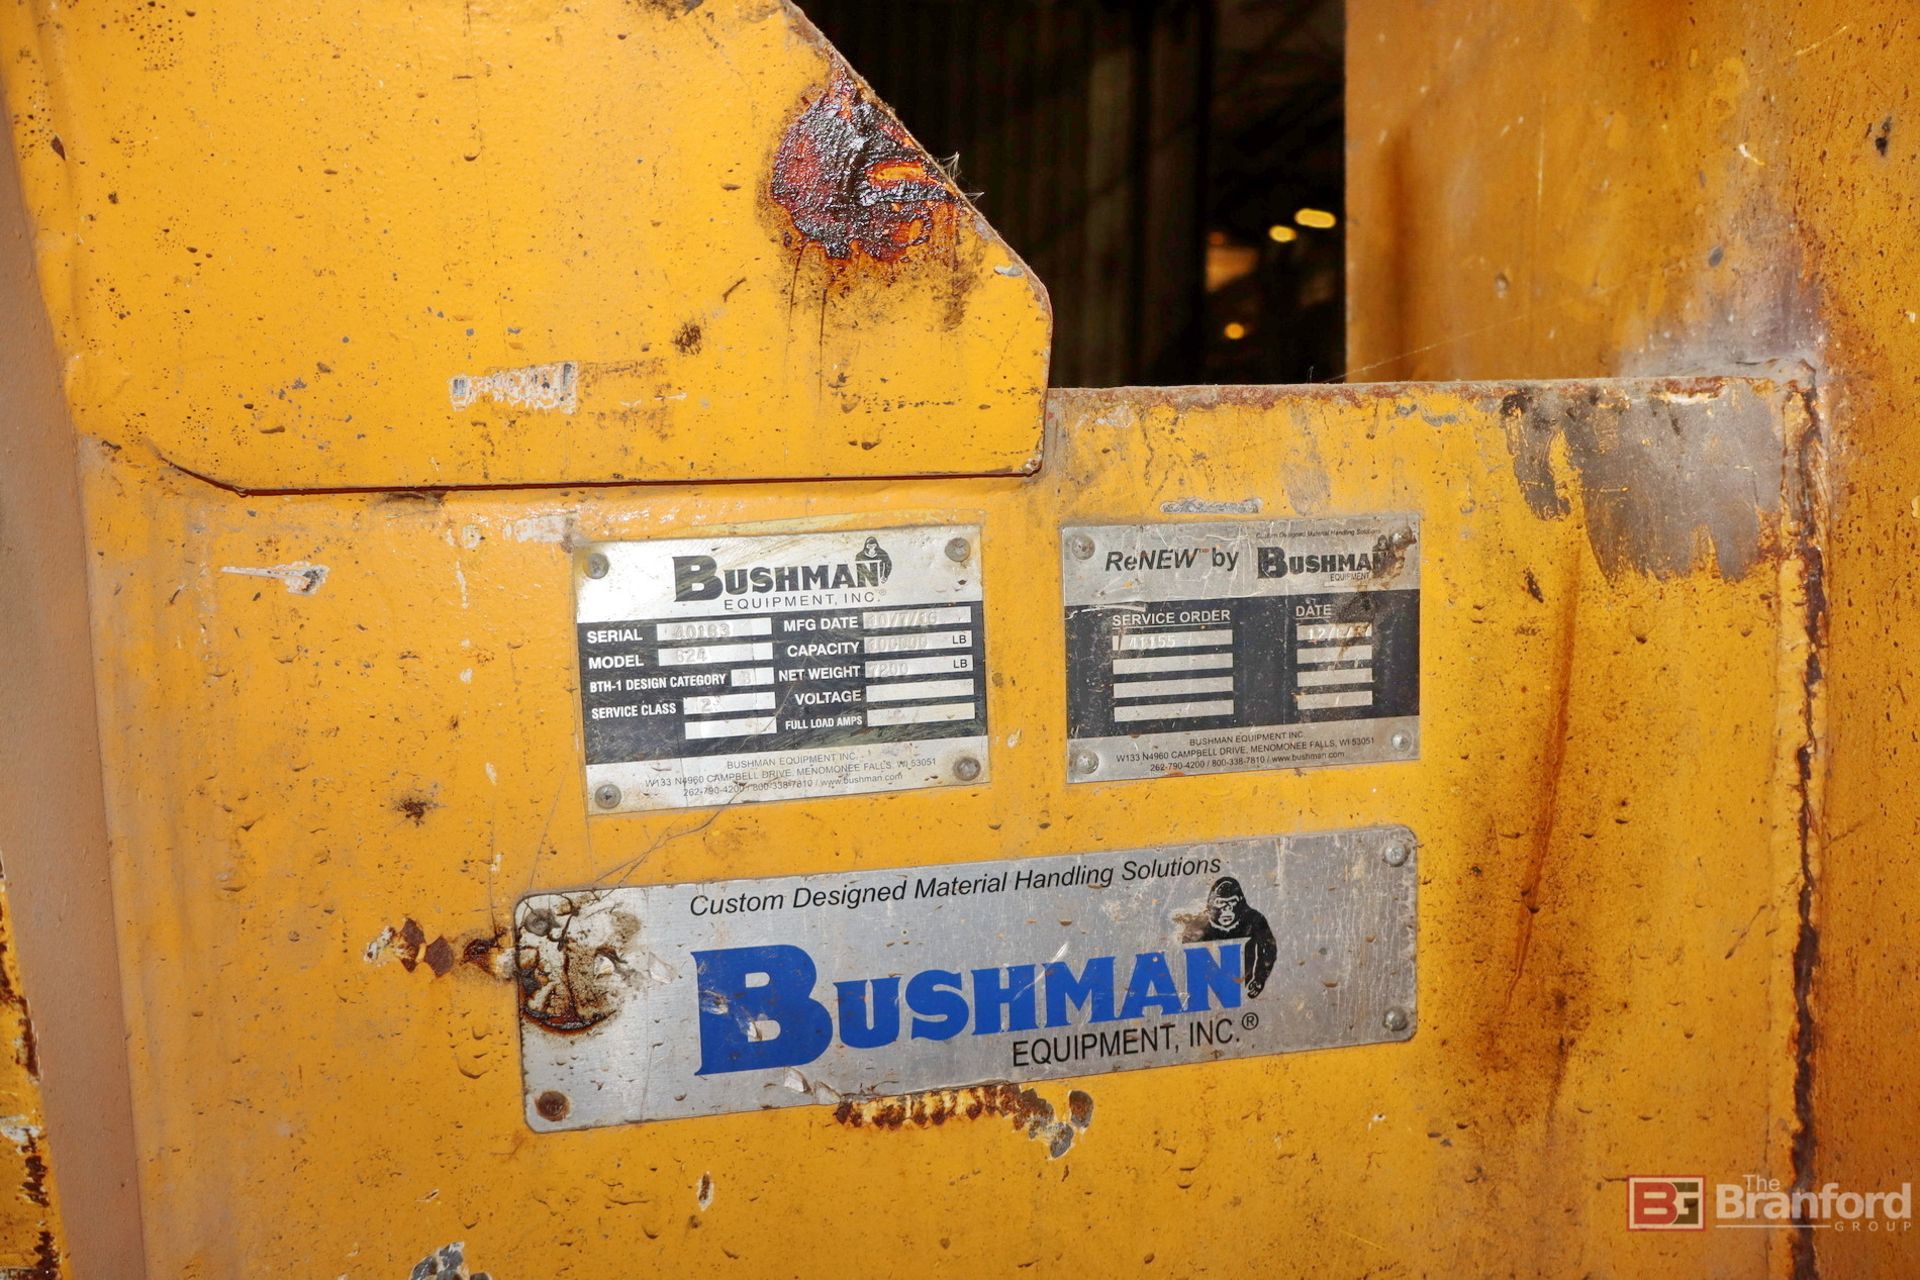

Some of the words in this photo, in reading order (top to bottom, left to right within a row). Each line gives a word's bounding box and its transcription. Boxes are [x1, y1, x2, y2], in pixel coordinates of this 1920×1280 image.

[1212, 547, 1239, 572] by
[672, 555, 880, 602] BUSHMAN
[1330, 572, 1370, 582] EQUIPMENT
[724, 593, 838, 611] EQUIPMENT,
[1296, 604, 1331, 617] DATE
[783, 618, 816, 633] MFG
[820, 616, 859, 630] DATE
[1113, 612, 1175, 627] SERVICE
[1180, 609, 1231, 623] ORDER
[587, 629, 643, 644] SERIAL
[787, 642, 860, 658] CAPACITY
[952, 634, 967, 645] LB
[588, 654, 645, 669] MODEL
[778, 669, 804, 682] NET
[808, 665, 861, 680] WEIGHT
[953, 658, 968, 669] LB
[590, 679, 622, 693] BTH-1
[626, 677, 667, 691] DESIGN
[670, 673, 726, 688] CATEGORY
[795, 690, 861, 705] VOLTAGE
[591, 704, 638, 720] SERVICE
[641, 702, 677, 717] CLASS
[785, 720, 808, 730] FULL
[810, 718, 834, 728] LOAD
[836, 715, 863, 726] AMPS
[1190, 736, 1233, 746] BUSHMAN
[1235, 731, 1286, 743] EQUIPMENT
[1116, 753, 1140, 763] W133
[1142, 752, 1168, 761] N4960
[1171, 749, 1217, 760] CAMPBELL
[1250, 742, 1307, 753] MENOMONEE
[1339, 739, 1351, 747] WI
[1352, 737, 1375, 746] 53051
[727, 758, 776, 770] BUSHMAN
[779, 753, 836, 766] EQUIPMENT
[1150, 761, 1205, 772] 262-790-4200
[1212, 756, 1265, 768] 800-338-7810
[1271, 751, 1345, 763] www.bushman.com
[645, 777, 672, 788] W133
[675, 775, 704, 786] N4960
[707, 771, 759, 783] CAMPBELL
[796, 764, 860, 777] MENOMONEE
[912, 757, 936, 768] 53051
[690, 892, 784, 917] Custom
[792, 880, 906, 912] Designed
[914, 871, 1009, 898] Material
[1013, 865, 1114, 892] Handling
[1121, 856, 1222, 882] Solutions
[690, 943, 1244, 1077] BUSHMAN
[1012, 1024, 1180, 1067] EQUIPMENT,
